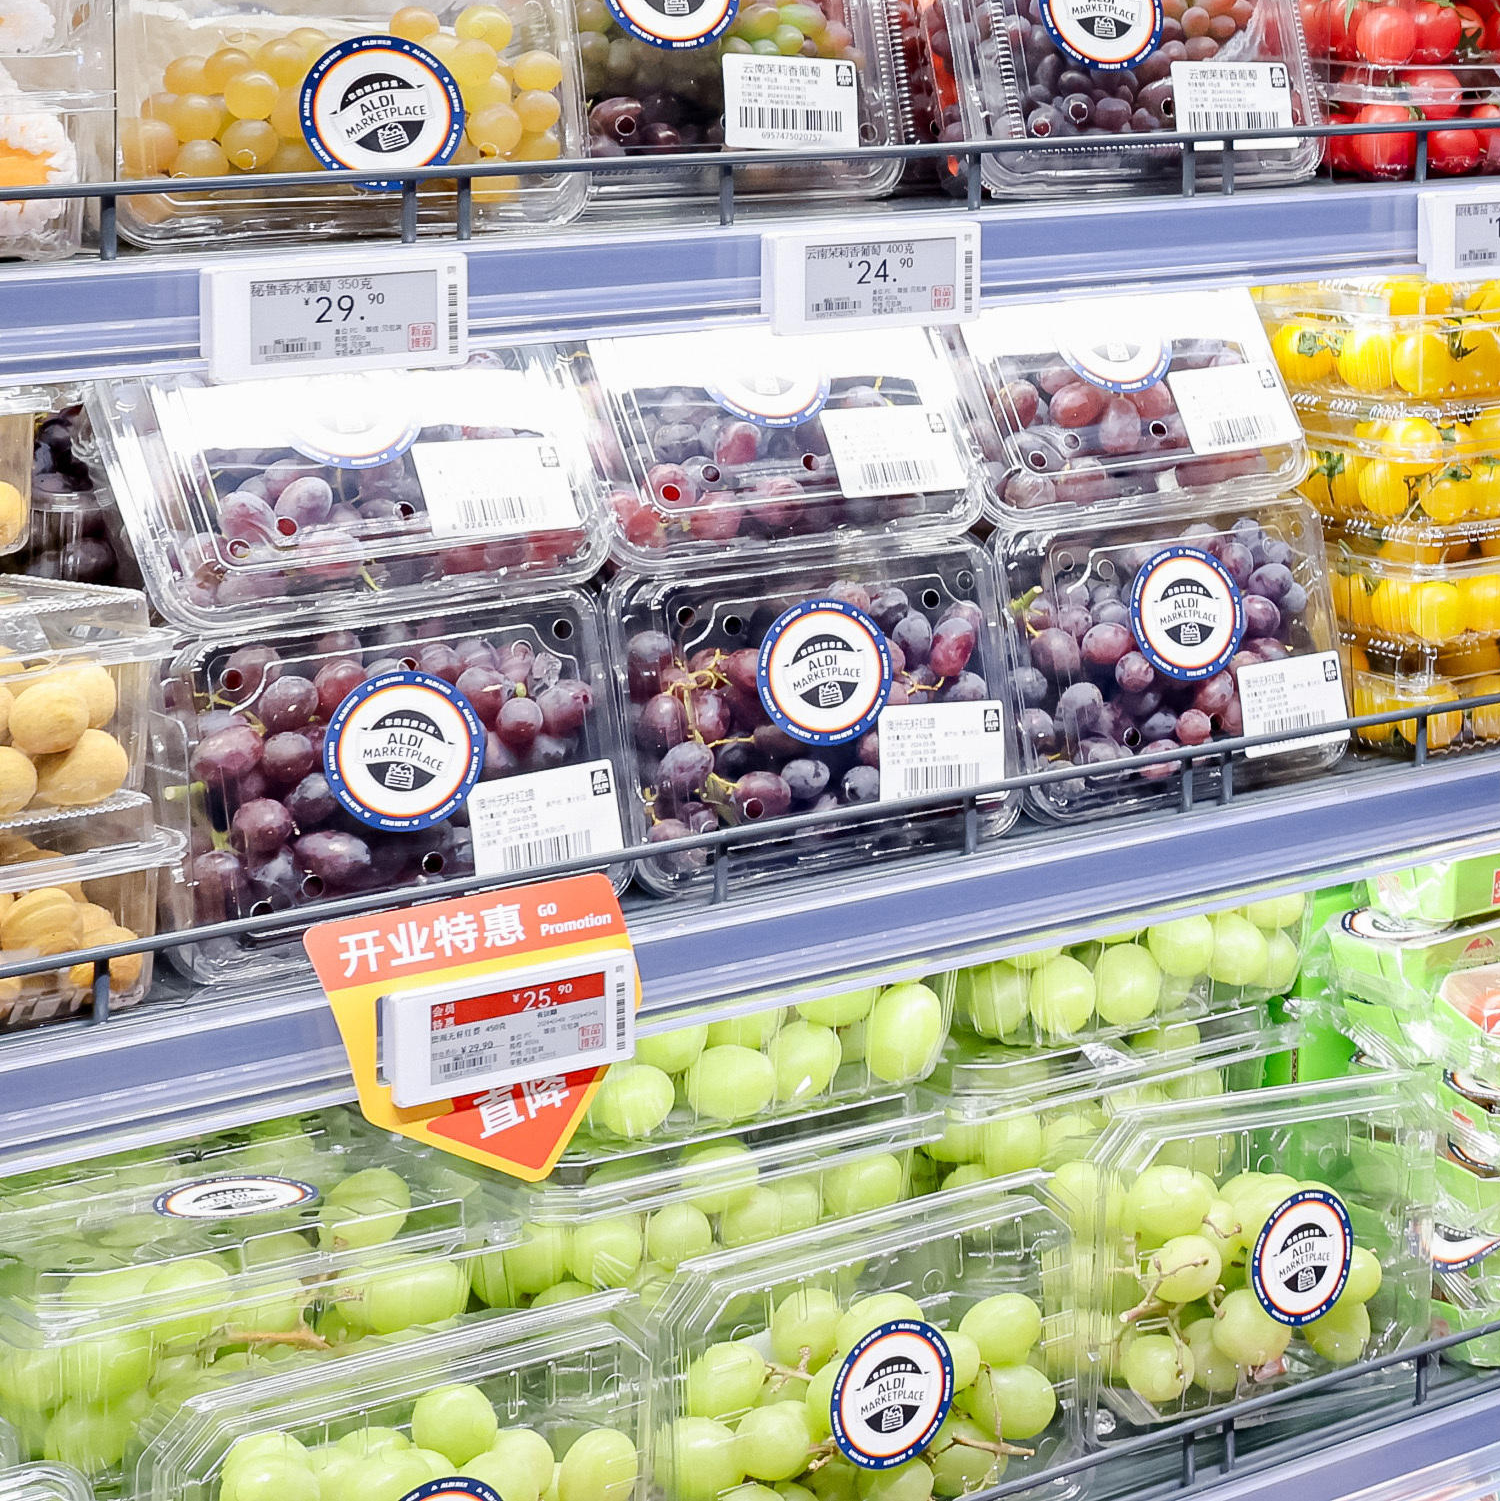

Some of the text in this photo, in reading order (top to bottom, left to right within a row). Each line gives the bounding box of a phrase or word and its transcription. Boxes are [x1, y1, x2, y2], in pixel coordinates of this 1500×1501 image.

[1071, 2, 1137, 22] MARKETPLACE
[359, 93, 396, 116] ALDI
[345, 104, 427, 139] MARKETPLACE
[251, 281, 332, 297] 秘鲁香水葡萄
[1173, 597, 1199, 610] ALDI
[1159, 608, 1217, 626] MARKETPLACE
[808, 653, 838, 672] ALDI
[792, 667, 862, 691] MARKETPLACE
[387, 732, 424, 749] ALDI
[362, 746, 445, 772] MARKETPLACE
[537, 902, 557, 916] GO
[540, 912, 612, 937] Promotion
[339, 904, 526, 978] 开业特惠
[432, 1003, 455, 1017] 会员
[1292, 1241, 1315, 1259] ALDI
[1279, 1251, 1331, 1279] MARKETPLACE
[877, 1377, 906, 1395] ALDI
[860, 1389, 925, 1416] MARKETPLACE
